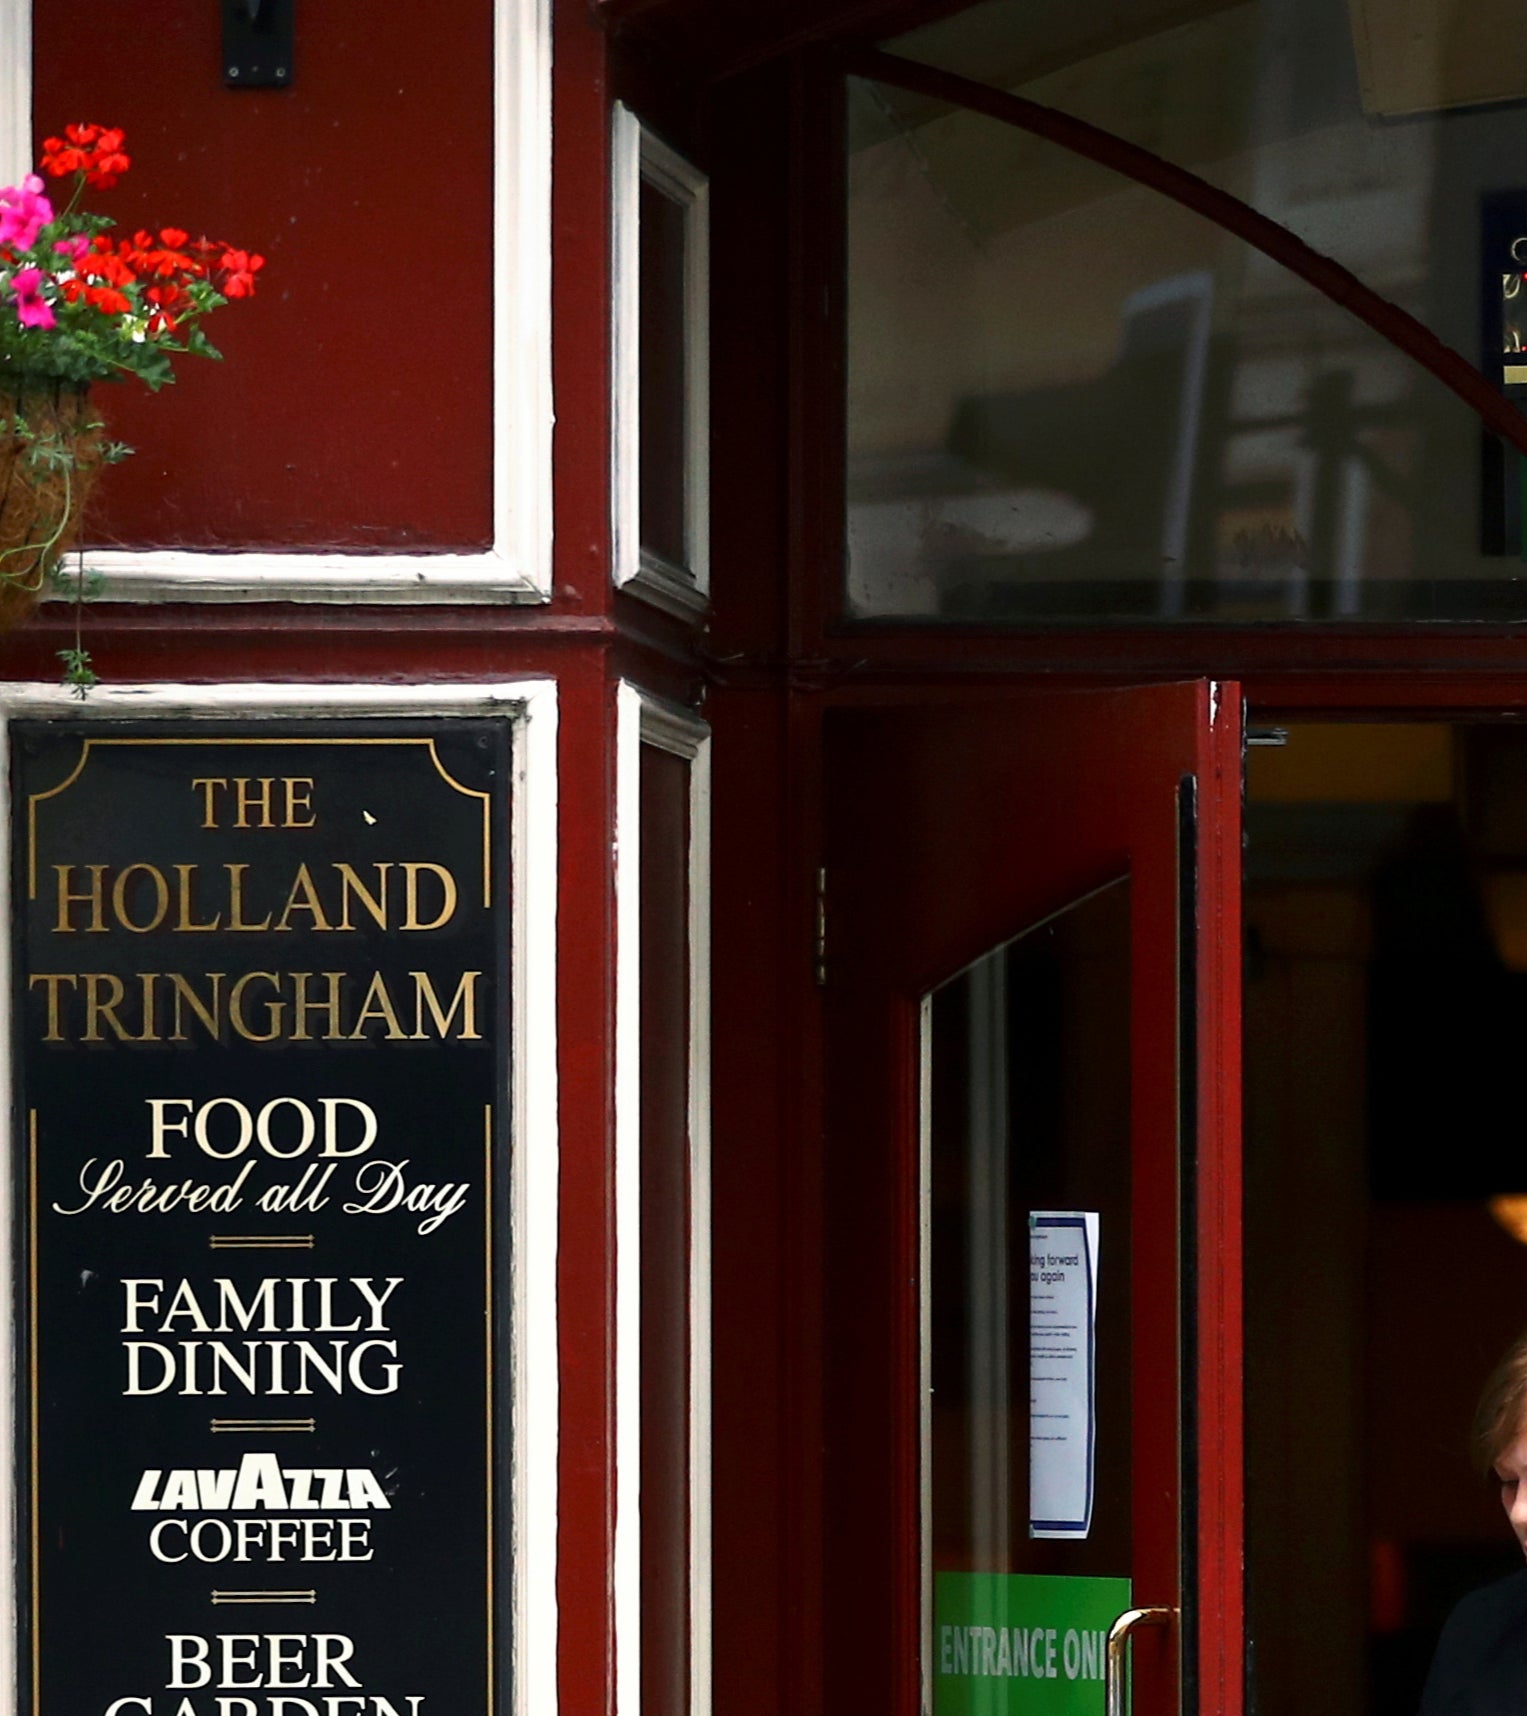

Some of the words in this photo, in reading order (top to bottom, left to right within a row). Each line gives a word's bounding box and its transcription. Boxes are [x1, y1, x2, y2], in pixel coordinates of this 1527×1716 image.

[192, 778, 317, 829] THE
[51, 862, 457, 933] HOLLAND
[29, 971, 483, 1042] TRINGHAM
[145, 1098, 378, 1159] FOOD
[52, 1158, 257, 1216] Served
[257, 1163, 337, 1213] all
[343, 1160, 470, 1235] Day
[1041, 1270, 1066, 1284] again
[1047, 1252, 1080, 1268] forward
[120, 1277, 404, 1333] FAMILY
[122, 1340, 404, 1396] DINING
[131, 1453, 392, 1511] LAVAZZA
[149, 1518, 374, 1563] COFFEE
[165, 1634, 362, 1690] BEER
[941, 1625, 1058, 1680] ENTRANCE
